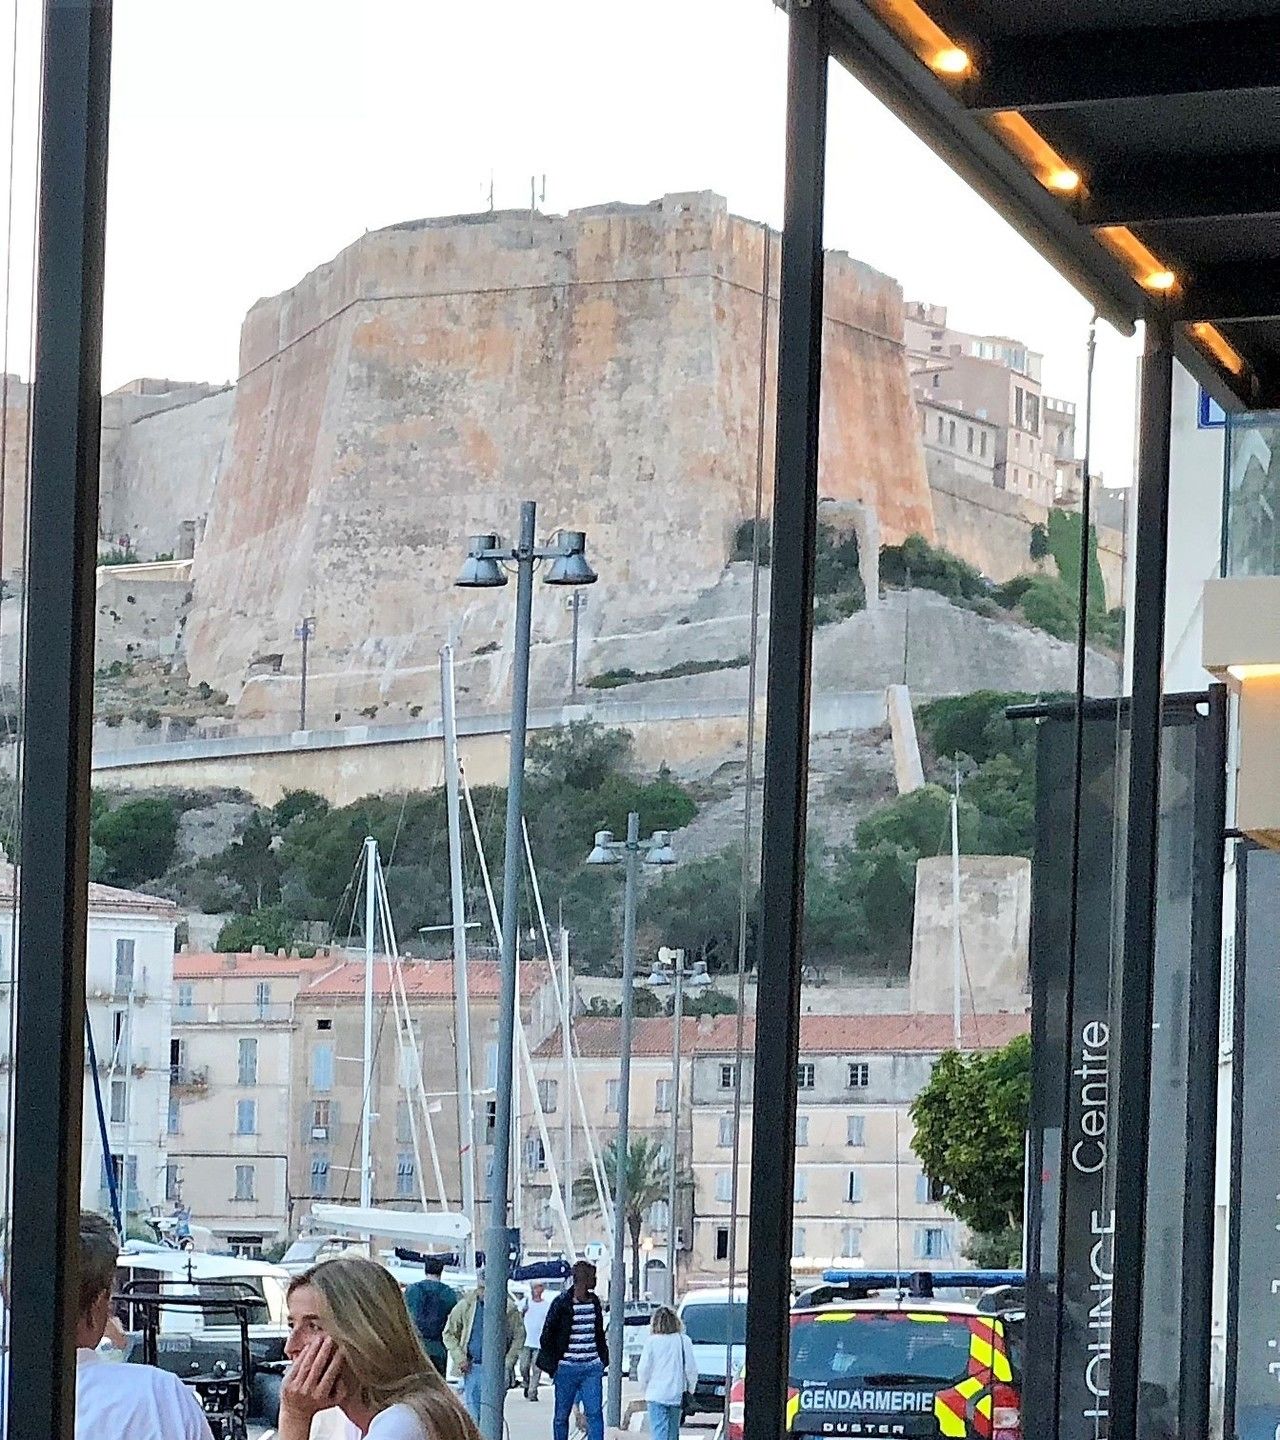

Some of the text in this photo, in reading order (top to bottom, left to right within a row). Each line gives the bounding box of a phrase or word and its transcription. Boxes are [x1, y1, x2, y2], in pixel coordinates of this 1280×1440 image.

[1071, 1021, 1110, 1174] Centre
[800, 1389, 934, 1412] GENDARMERIE
[823, 1422, 905, 1434] DUSTER
